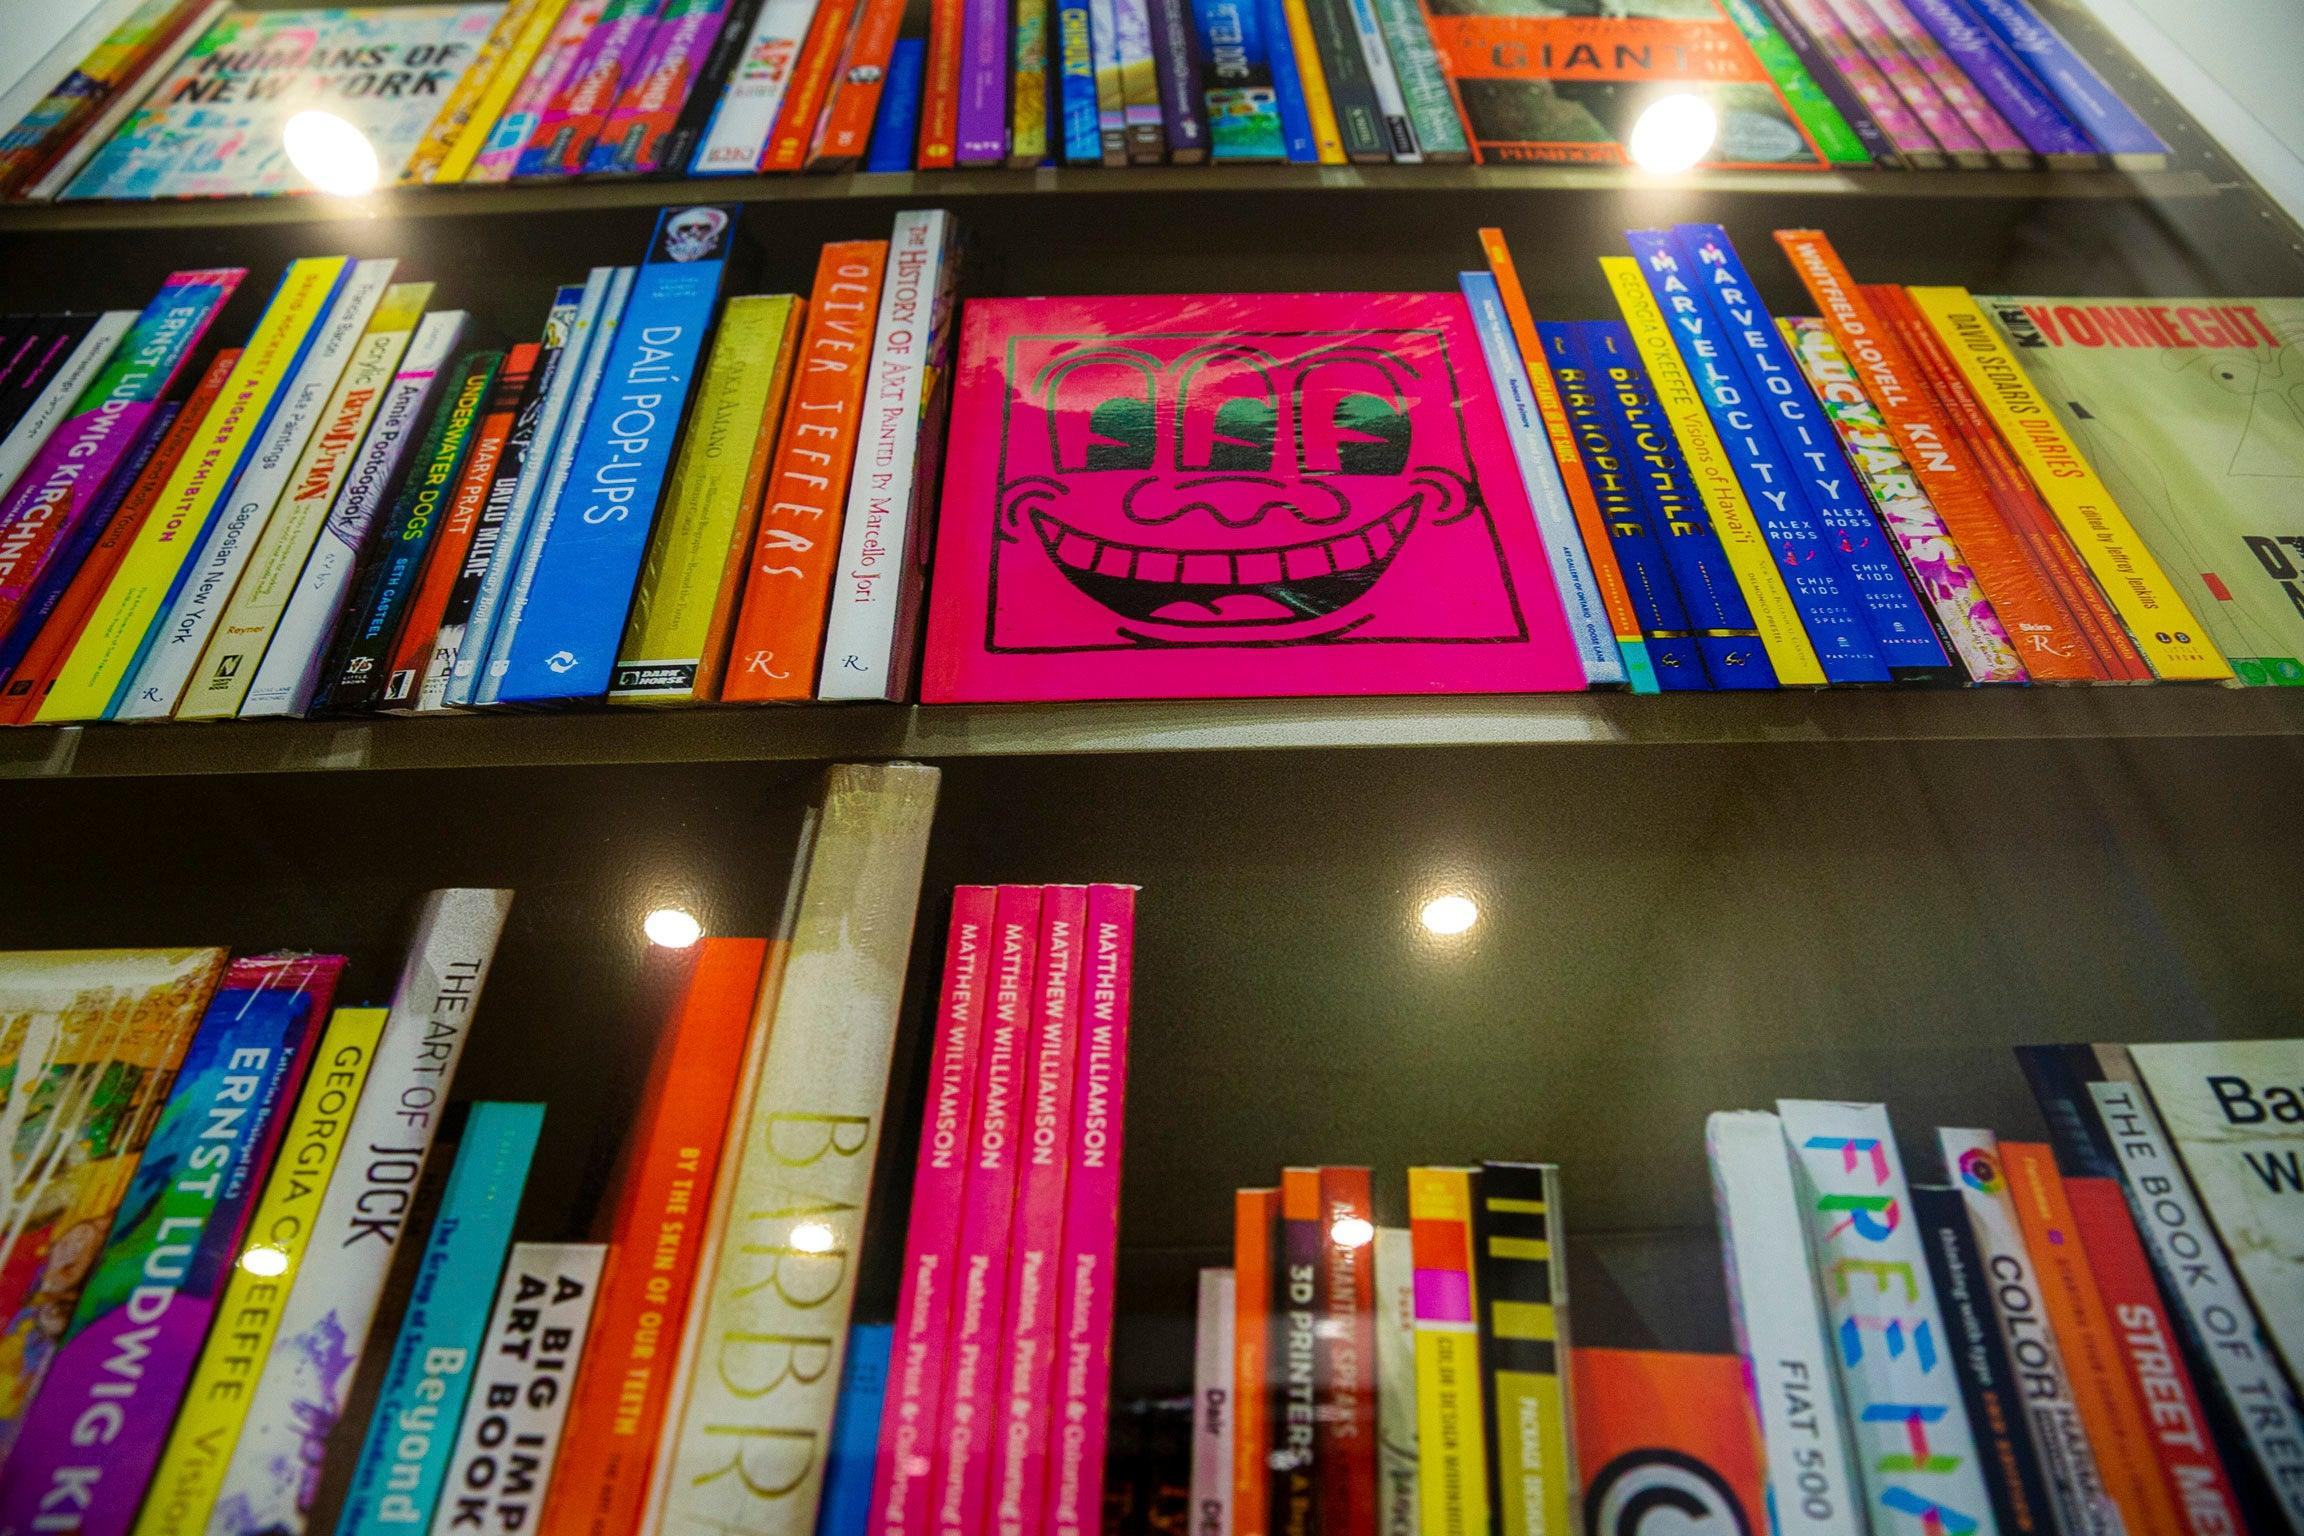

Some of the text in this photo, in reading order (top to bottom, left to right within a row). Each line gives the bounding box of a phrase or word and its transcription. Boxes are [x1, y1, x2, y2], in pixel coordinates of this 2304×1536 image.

[403, 42, 470, 66] OF
[1491, 42, 1690, 70] GIANT
[892, 249, 928, 325] HISTORY
[134, 306, 197, 368] ERNST
[627, 325, 682, 384] DALÍ
[886, 330, 913, 355] OF
[1796, 242, 1866, 335] WHITFIELD
[1853, 338, 1909, 408] LOVELL
[1903, 423, 1957, 472] KIN
[2021, 304, 2282, 349] VONNEGUT
[245, 379, 258, 387] A
[355, 336, 390, 385] acrylic
[879, 360, 911, 401] ART
[1508, 378, 1523, 401] Rebecca
[1618, 271, 1730, 485] GEORGIA O'KEEFFE Visions of
[1650, 253, 1787, 511] MARVELOCITY
[1698, 247, 1841, 499] MARVELOCITY
[67, 372, 150, 459] LUDWIG
[214, 391, 254, 445] BIGGER
[294, 382, 322, 409] Late
[762, 263, 870, 580] OLIVER JEFFERS
[1947, 313, 1997, 352] DAVID
[1976, 355, 2041, 415] SEDARIS
[2018, 419, 2086, 479] DIARIES
[262, 412, 305, 470] Paintings
[338, 384, 420, 527] Annie Pootoogook
[402, 374, 488, 542] UNDERWATER DOGS
[583, 394, 662, 525] POP-UPS
[706, 401, 740, 459] AMANO
[1557, 367, 1645, 538] BIBLIOPHILE
[1608, 367, 1705, 537] BIBLIOPHILE
[1799, 330, 1881, 425] LUCY
[1848, 430, 1956, 561] JARVIS
[158, 449, 222, 543] EXHIBITION
[448, 437, 501, 535] MARY PRATT
[1822, 508, 1865, 517] ALEX
[101, 510, 133, 549] Young
[215, 502, 259, 567] Gagosian
[537, 512, 556, 530] 25th
[860, 497, 892, 567] Marcello
[1561, 546, 1571, 556] ART
[1768, 520, 1812, 529] ALEX
[1770, 531, 1818, 540] ROSS
[1825, 518, 1872, 527] ROSS
[463, 527, 500, 579] MILNE
[471, 511, 522, 624] 25th Anniversary Book
[515, 534, 549, 593] Anniversary
[1565, 557, 1579, 581] GALLERY
[1795, 577, 1834, 586] CHIP
[1852, 564, 1888, 572] CHIP
[1856, 573, 1894, 581] KIDD
[2078, 504, 2160, 611] Edited by Jeffrey Jenkins
[192, 570, 225, 605] New
[365, 557, 408, 640] SETH CASTEEL
[507, 596, 529, 624] Book
[851, 570, 881, 604] Jori
[1576, 592, 1591, 618] ONTARIO
[1745, 573, 1785, 643] DELMONICO PRESTEL
[1801, 586, 1839, 595] KIDD
[2072, 576, 2135, 659] Gallery Nova Scotia
[171, 609, 202, 644] York
[225, 625, 265, 636] Reyner
[1586, 623, 1605, 662] GOOSE LANE
[2018, 622, 2053, 632] Skira
[638, 676, 684, 685] HORSE
[642, 669, 681, 677] DARK
[745, 650, 790, 679] R
[842, 654, 868, 672] R
[930, 922, 979, 1170] MATTHEW WILLIAMSON
[979, 922, 1024, 1170] MATTHEW WILLIAMSON
[1030, 919, 1069, 1167] MATTHEW WILLIAMSON
[1082, 922, 1119, 1168] MATTHEW WILLIAMSON
[280, 1044, 363, 1207] GEORGIA
[342, 957, 483, 1249] THE ART OF JOCK
[69, 1046, 269, 1450] ERNST LUDWIG
[2103, 1092, 2254, 1365] THE BOOK OF
[500, 1274, 547, 1360] ART
[551, 1274, 584, 1302] A
[613, 1147, 700, 1437] BY THE SKIN OF OUR TEETH
[1935, 1227, 1996, 1386] thinking with type
[1991, 1254, 2060, 1404] COLOR
[525, 1327, 575, 1409] BIG
[1288, 1264, 1315, 1467] 3D PRINTERS
[2117, 1304, 2210, 1455] STREET
[379, 1346, 467, 1523] Beyond
[450, 1383, 519, 1529] BOOK
[1778, 1358, 1834, 1522] FIAT 500
